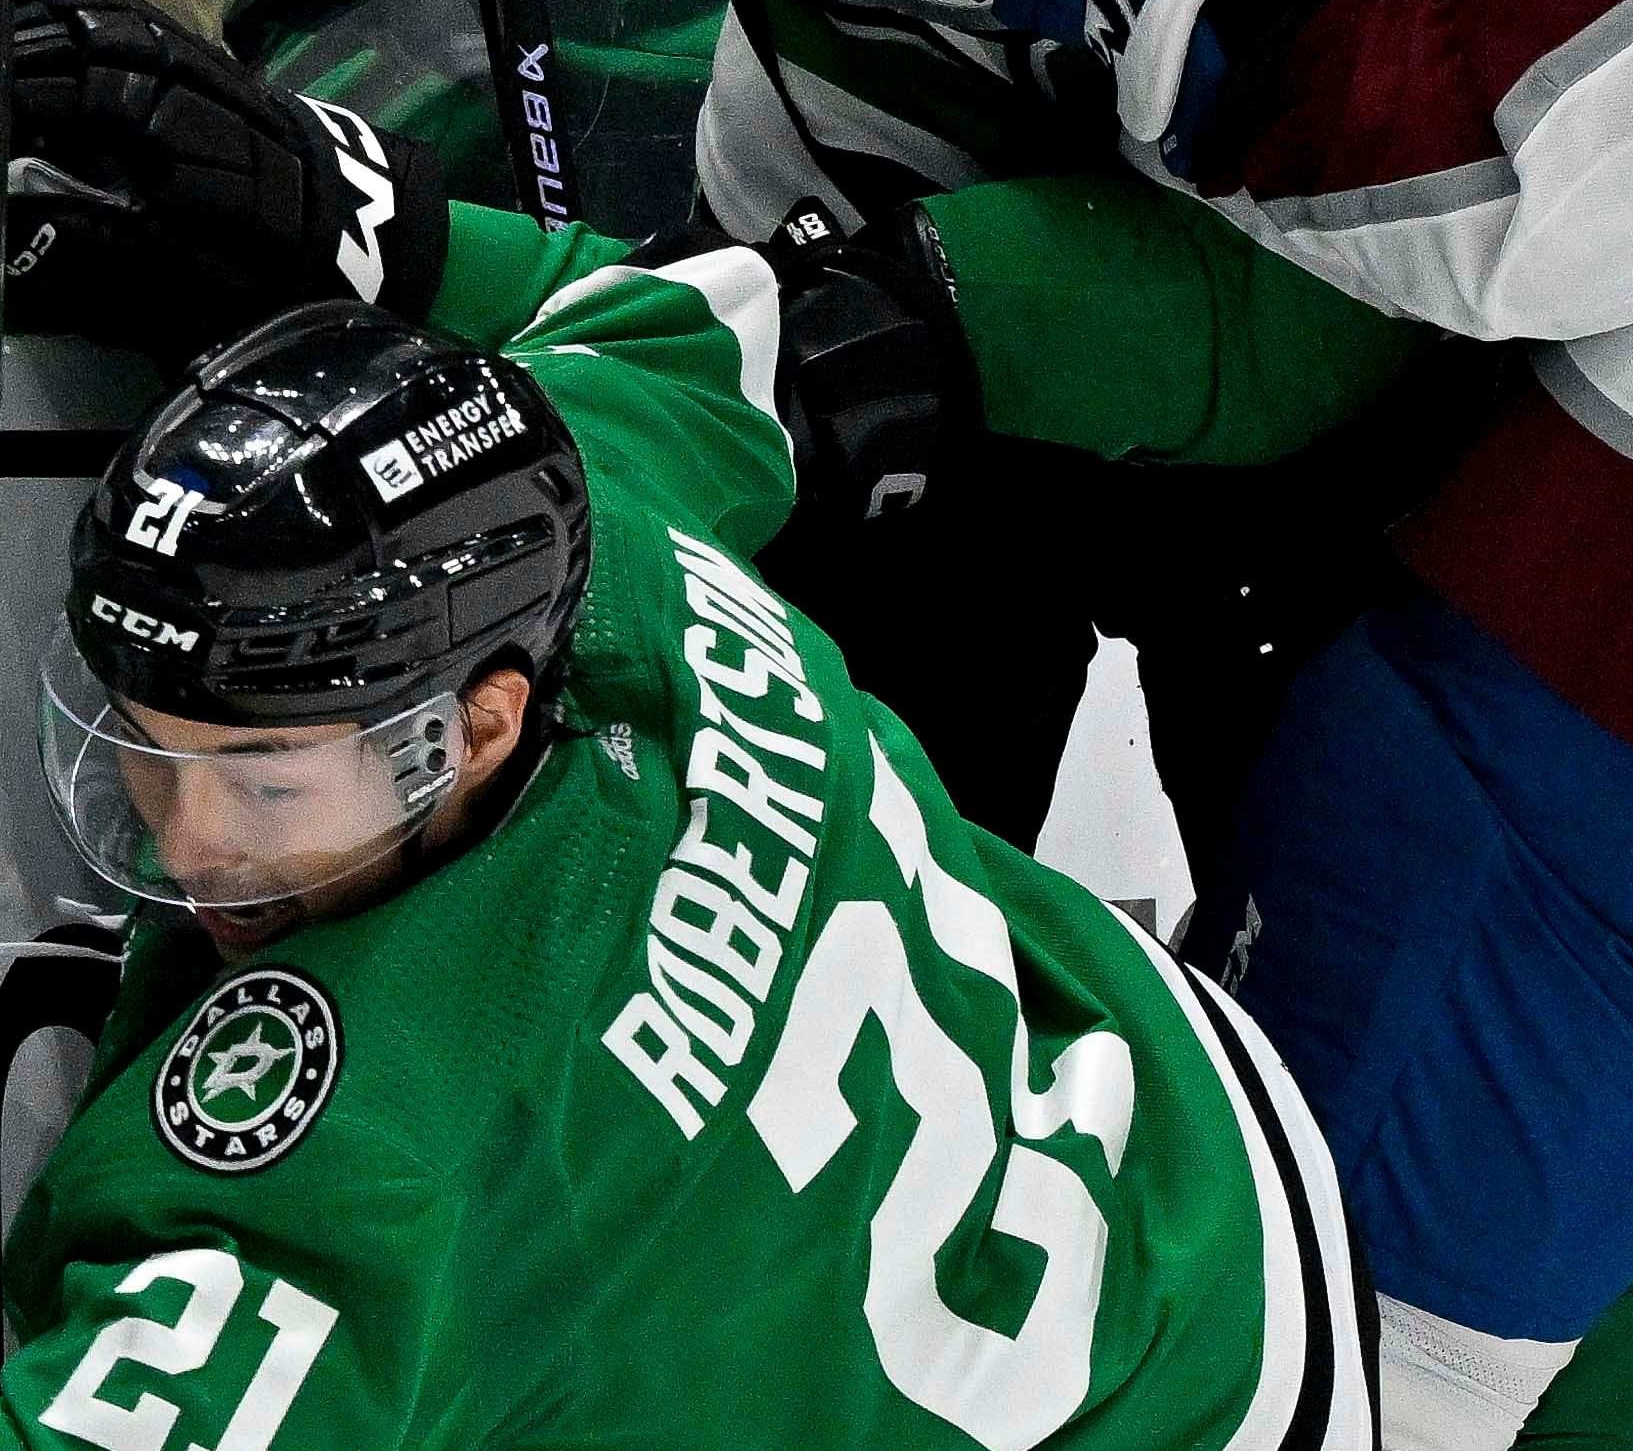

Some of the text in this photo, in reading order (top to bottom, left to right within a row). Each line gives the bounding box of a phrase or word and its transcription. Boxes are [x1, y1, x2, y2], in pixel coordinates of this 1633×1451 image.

[405, 391, 494, 453] ENERGY
[421, 407, 529, 479] TRANSFER
[125, 478, 205, 557] 21
[91, 593, 200, 652] CCM
[602, 526, 832, 1142] ROBERTSON
[178, 984, 325, 1058] DALLAS
[169, 1095, 306, 1157] STARS
